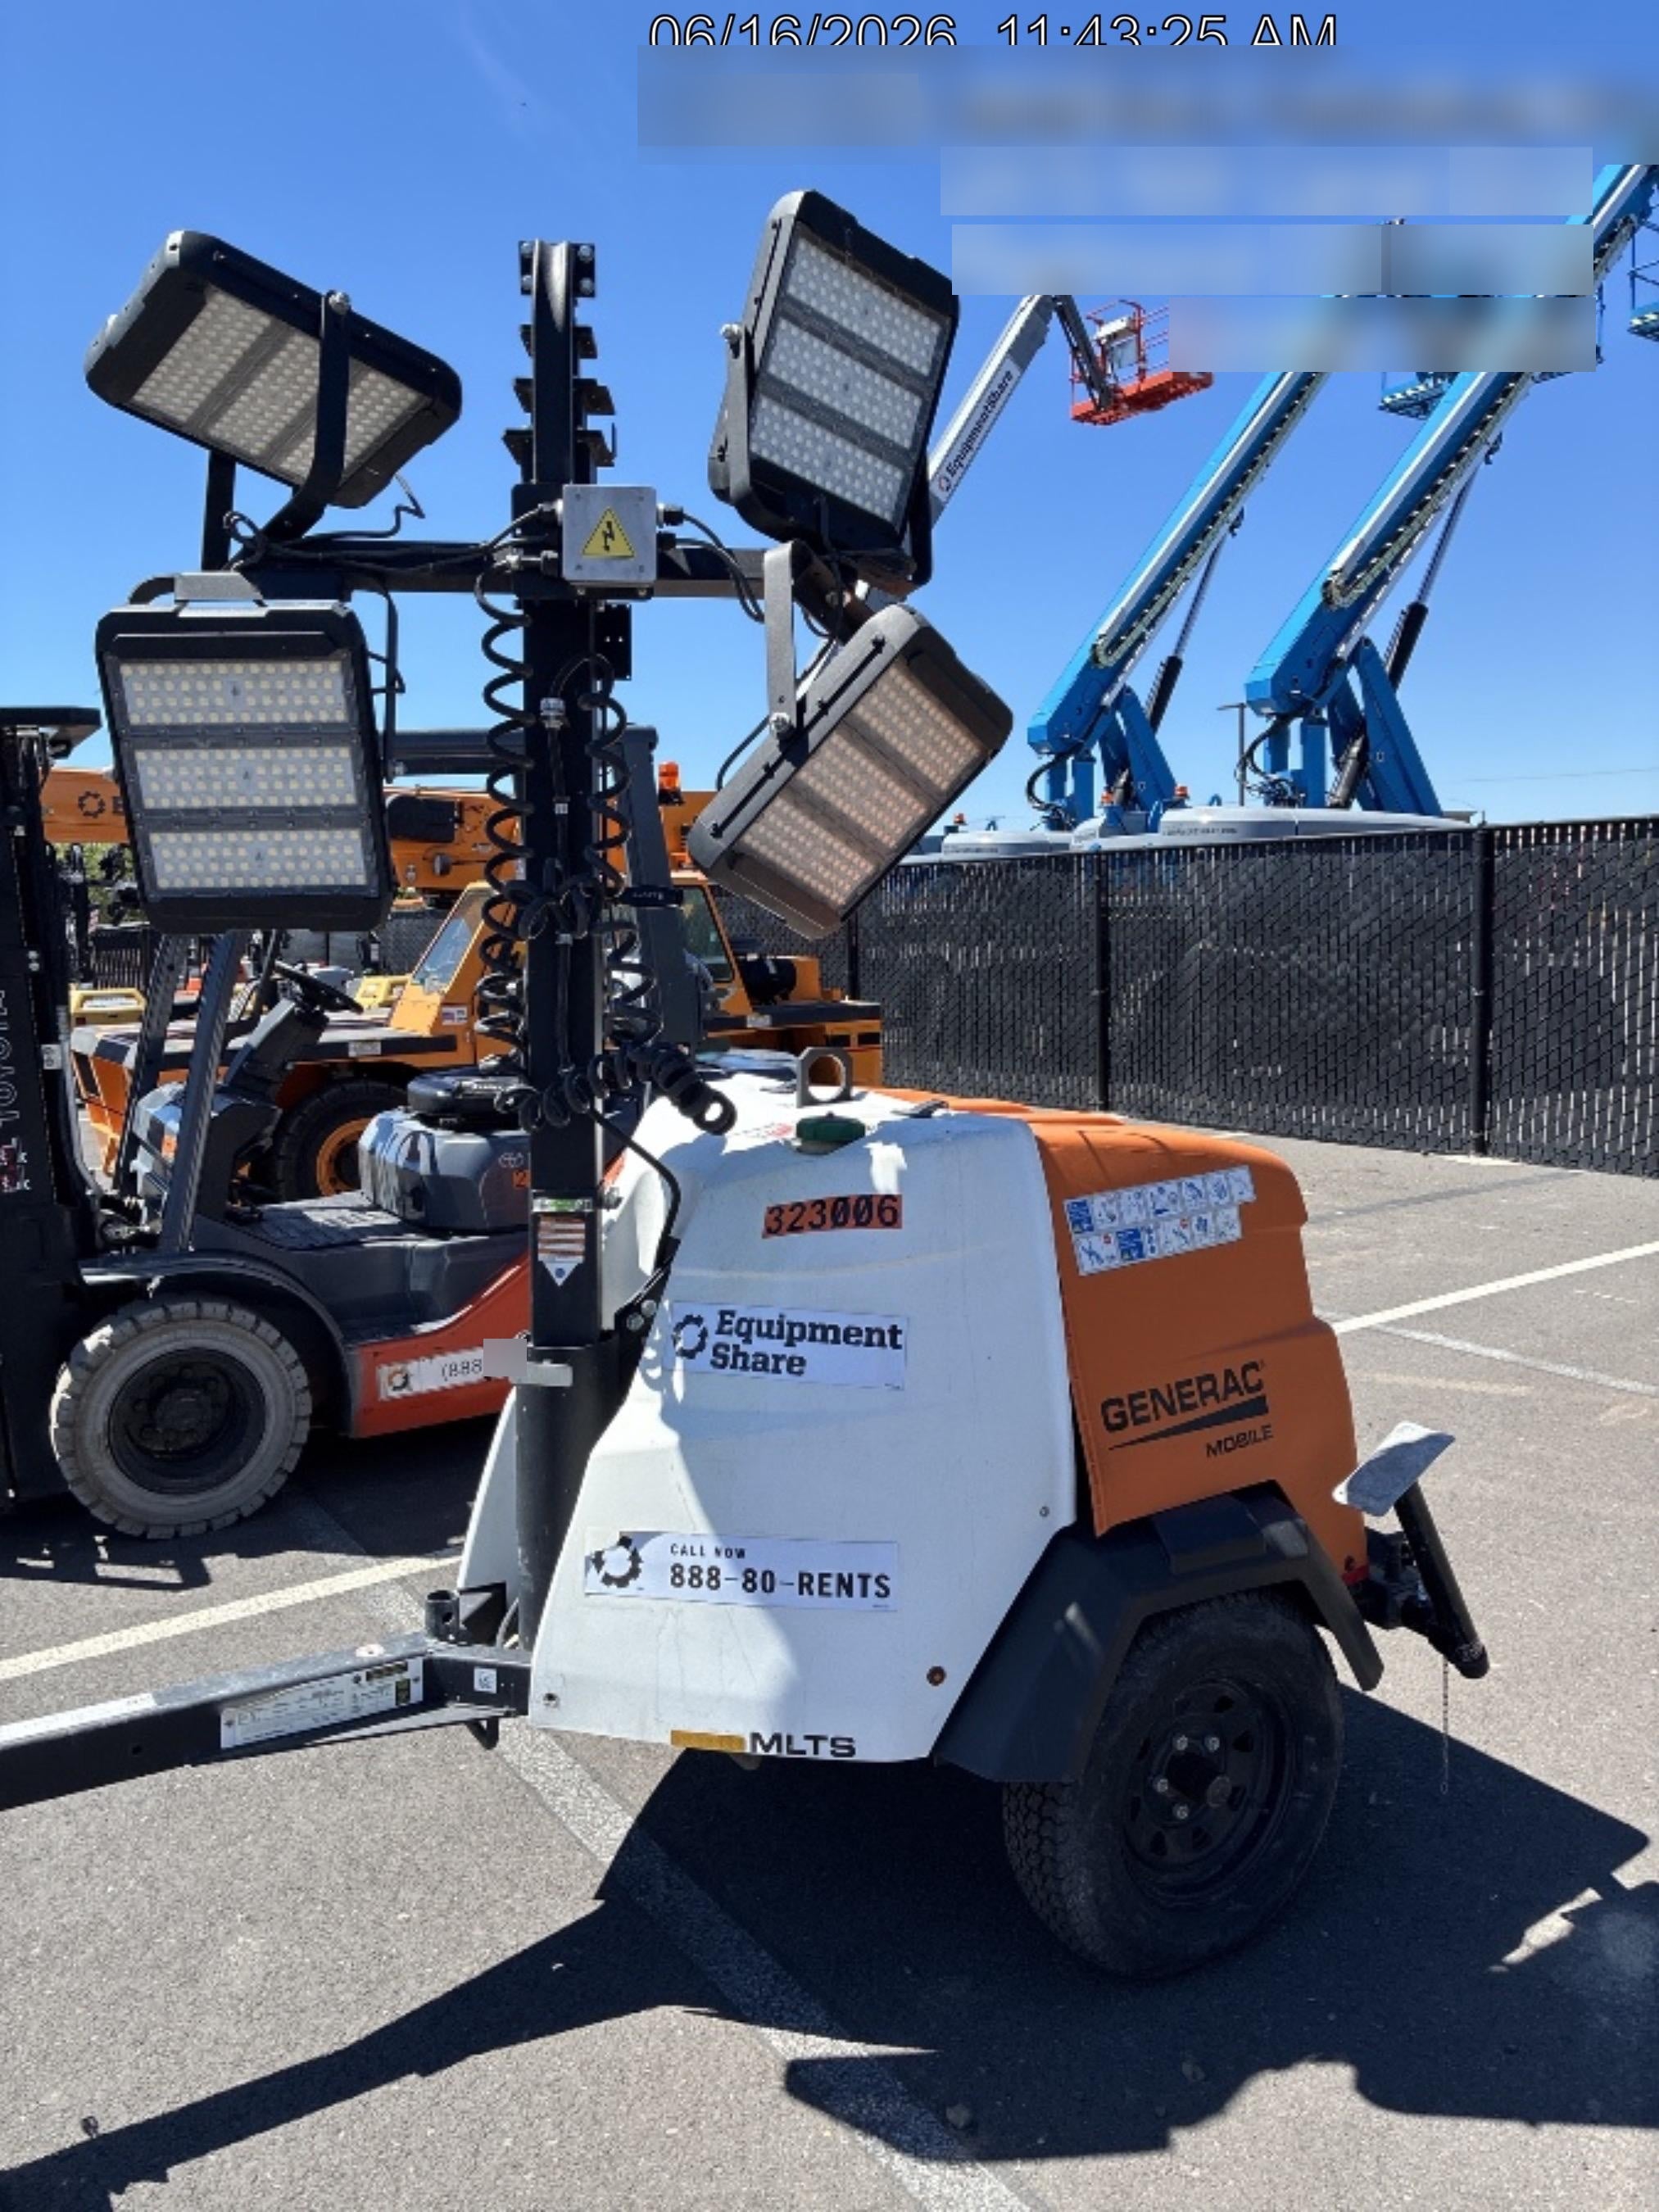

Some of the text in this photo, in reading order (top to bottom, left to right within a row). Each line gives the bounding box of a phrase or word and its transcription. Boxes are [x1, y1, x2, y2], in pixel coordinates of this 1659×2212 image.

[766, 1195, 900, 1235] 323006
[715, 1310, 903, 1349] Equipment
[710, 1343, 807, 1376] Share
[1100, 1362, 1264, 1433] GENERAC
[1206, 1425, 1274, 1459] MOBILE
[670, 1543, 746, 1560] CALL NOW
[670, 1563, 891, 1598] 888-80-RENTS
[750, 1732, 856, 1758] MLTS
